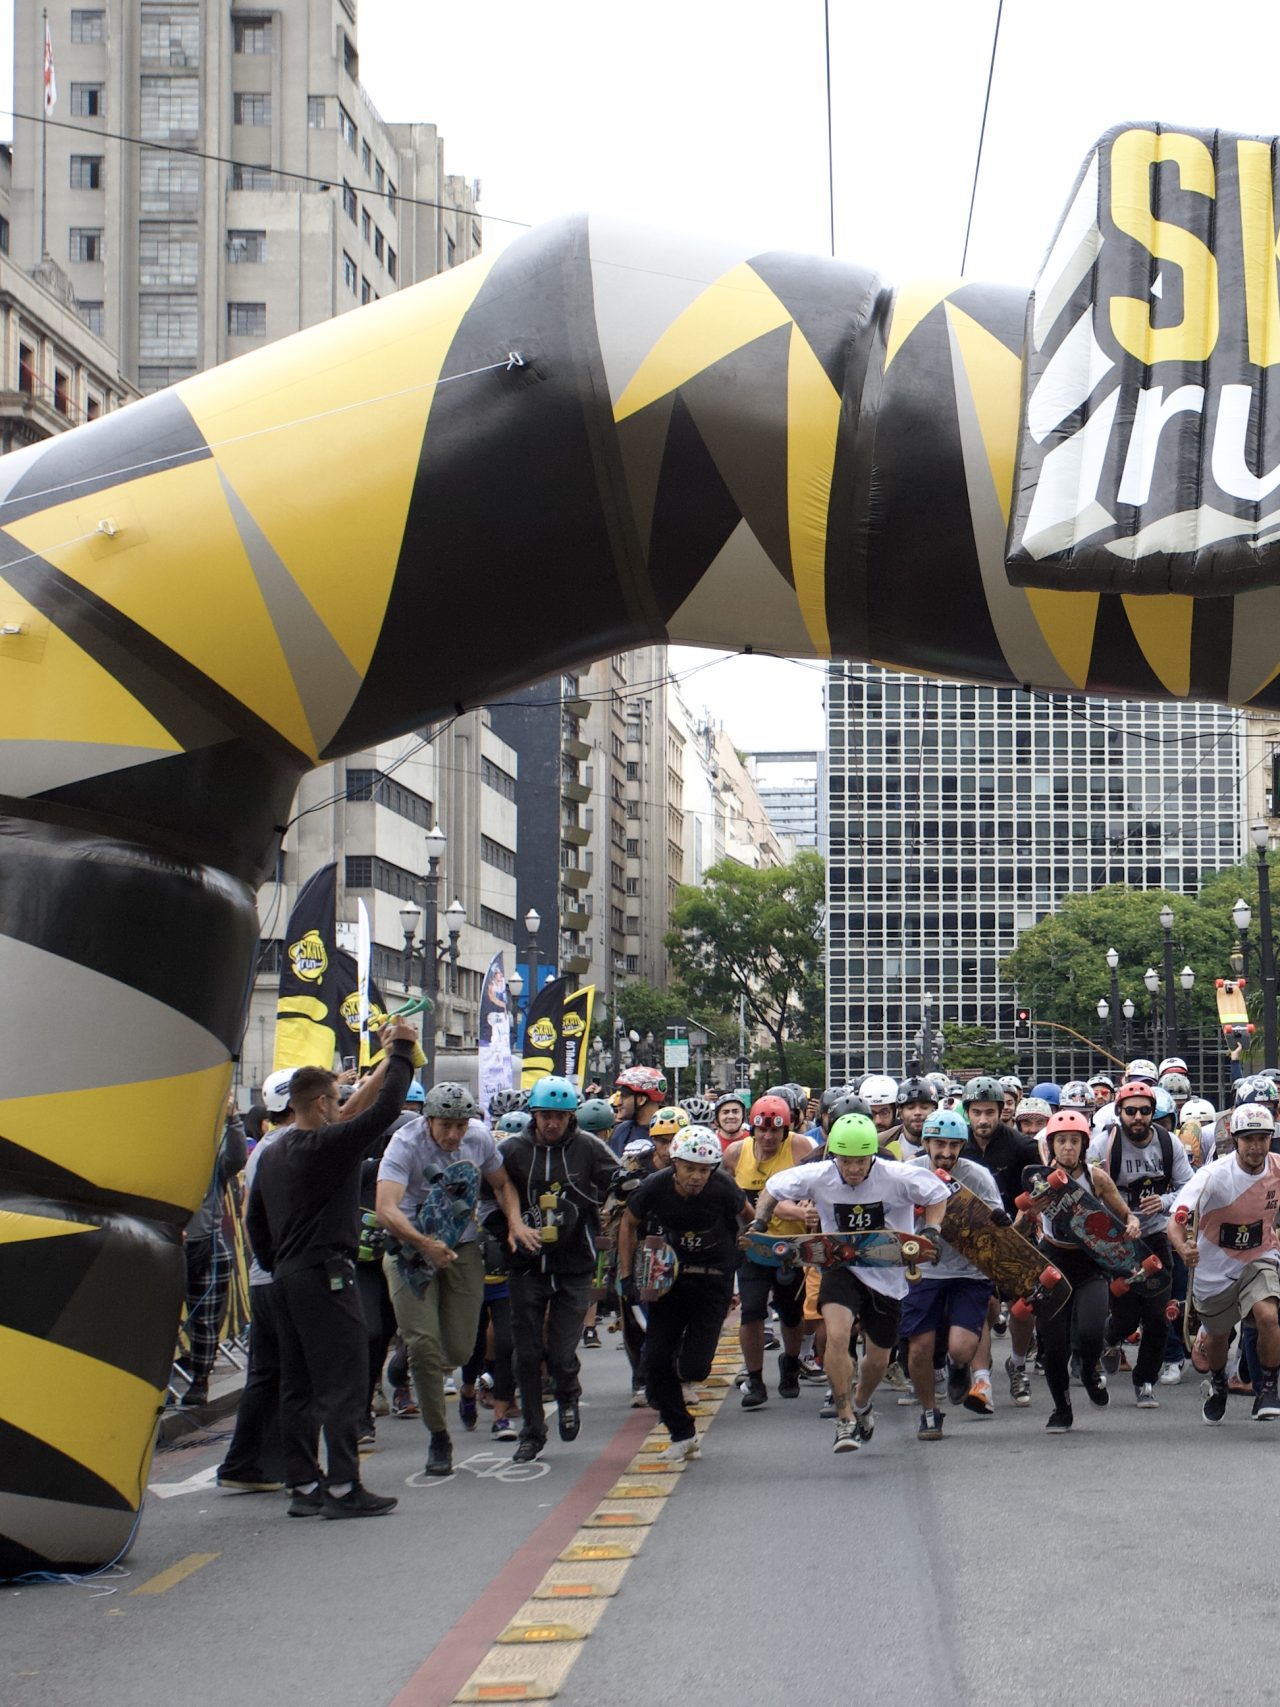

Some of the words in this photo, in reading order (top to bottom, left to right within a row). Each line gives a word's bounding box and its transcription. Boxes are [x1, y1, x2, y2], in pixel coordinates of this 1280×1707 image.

[847, 1213, 872, 1228] 243
[680, 1237, 703, 1247] 152
[1235, 1232, 1250, 1244] 20
